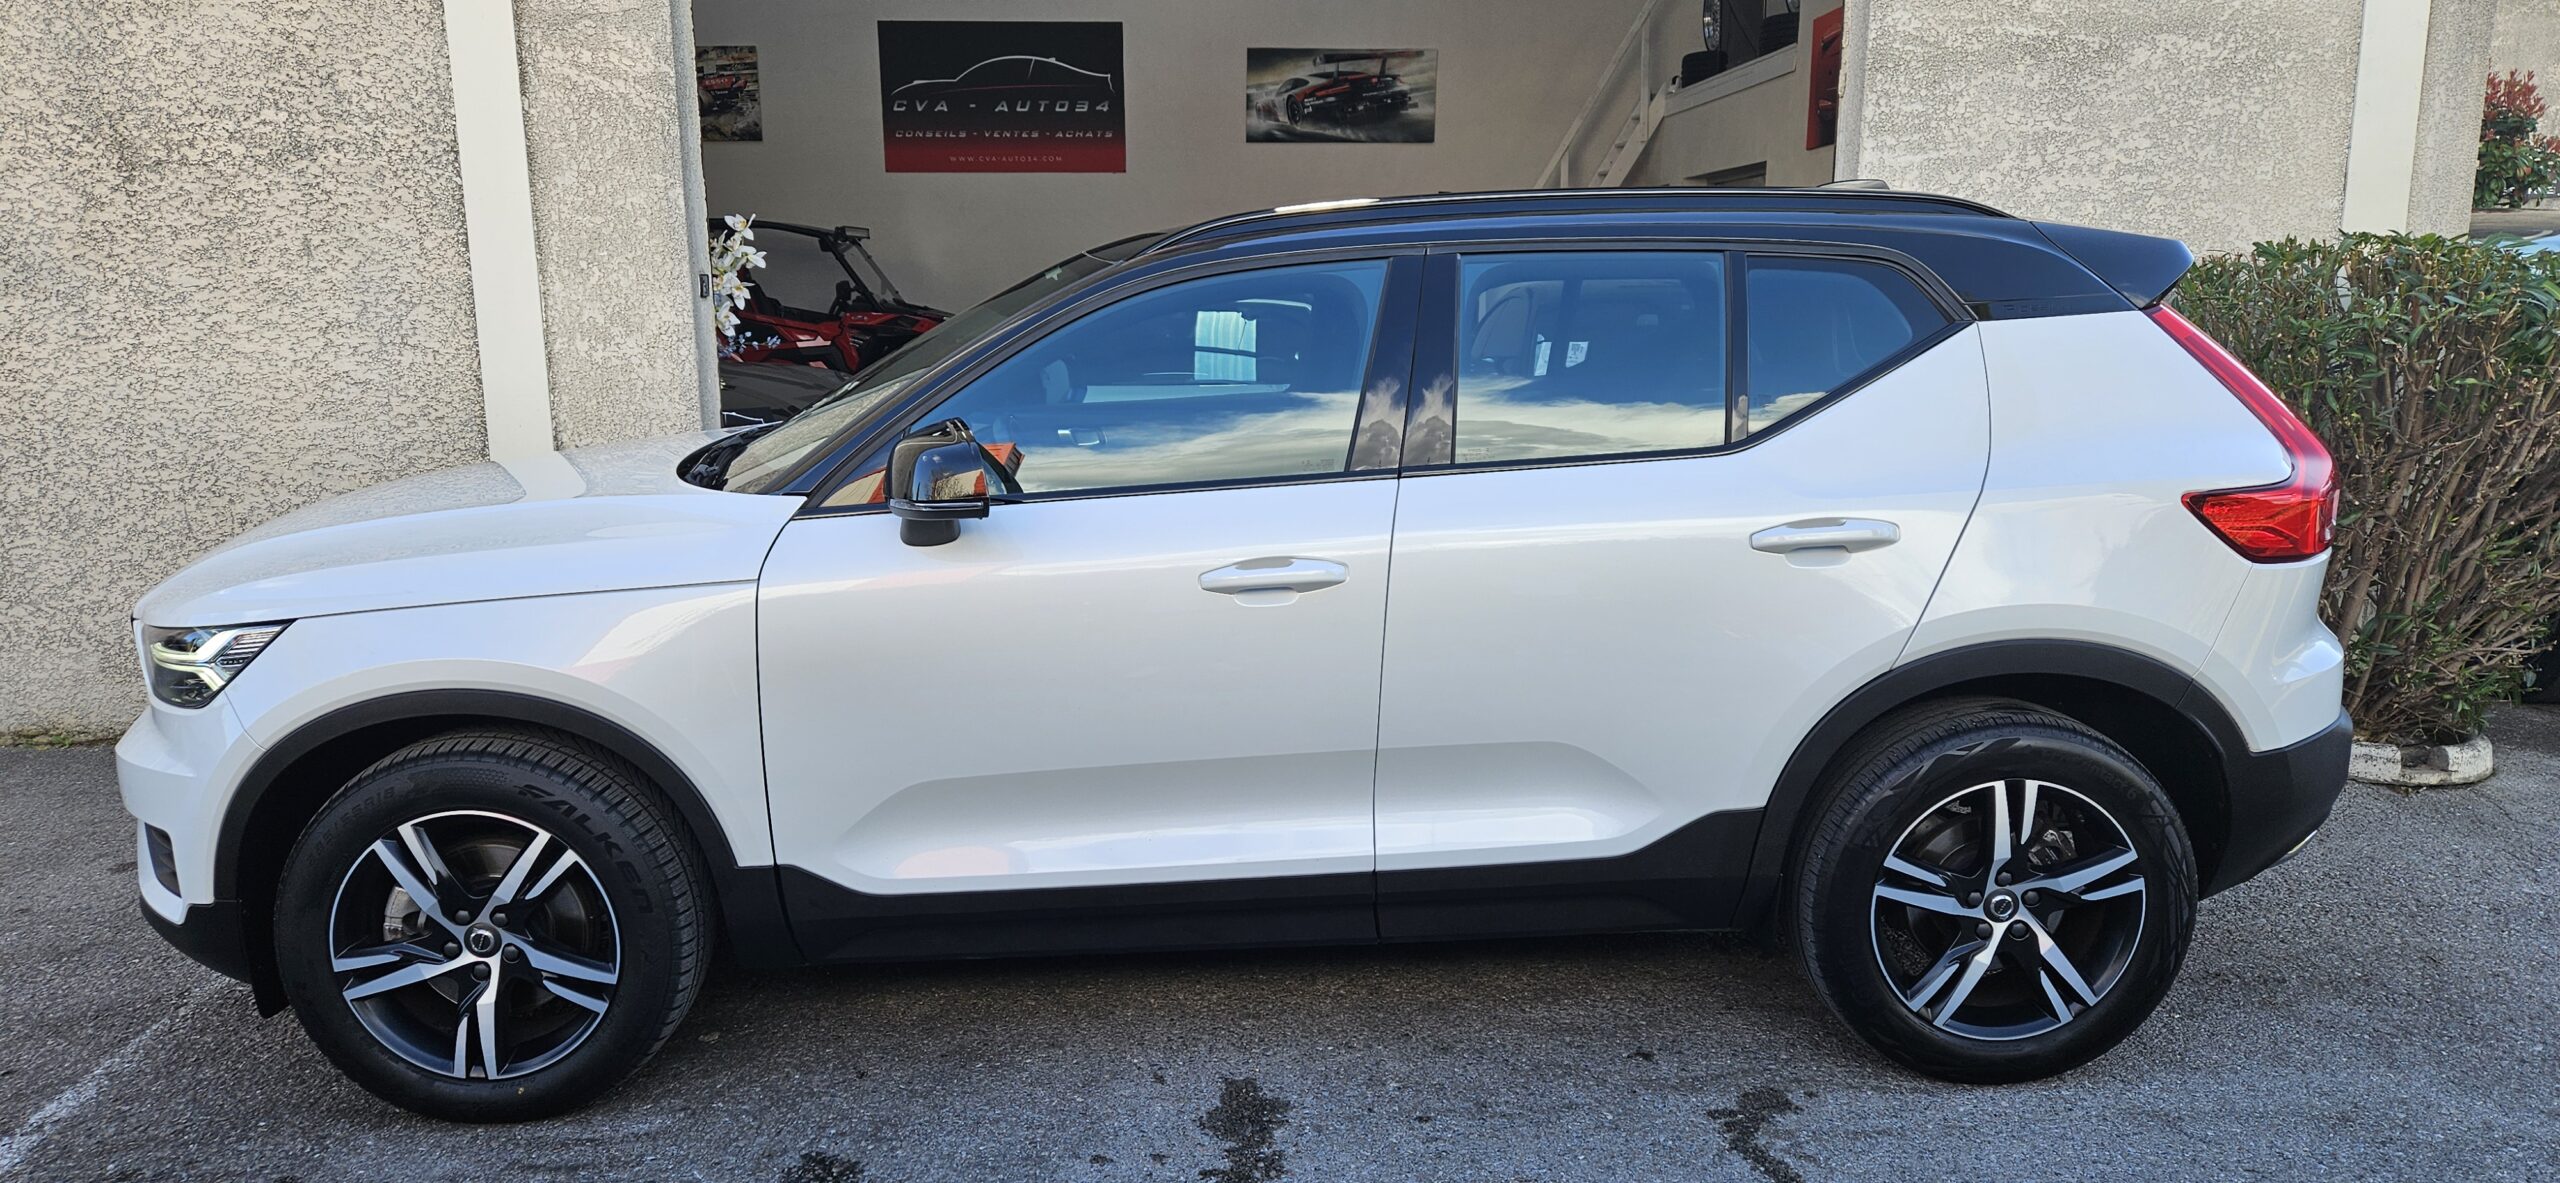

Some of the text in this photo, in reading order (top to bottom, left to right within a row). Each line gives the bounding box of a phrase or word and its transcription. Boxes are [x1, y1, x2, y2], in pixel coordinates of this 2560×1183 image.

[893, 100, 948, 112] CVA
[994, 100, 1110, 112] AUTO34
[896, 130, 967, 138] CONSEILS
[984, 130, 1039, 138] VENTES
[1055, 130, 1113, 138] ACHATS
[514, 784, 653, 914] FALKEN
